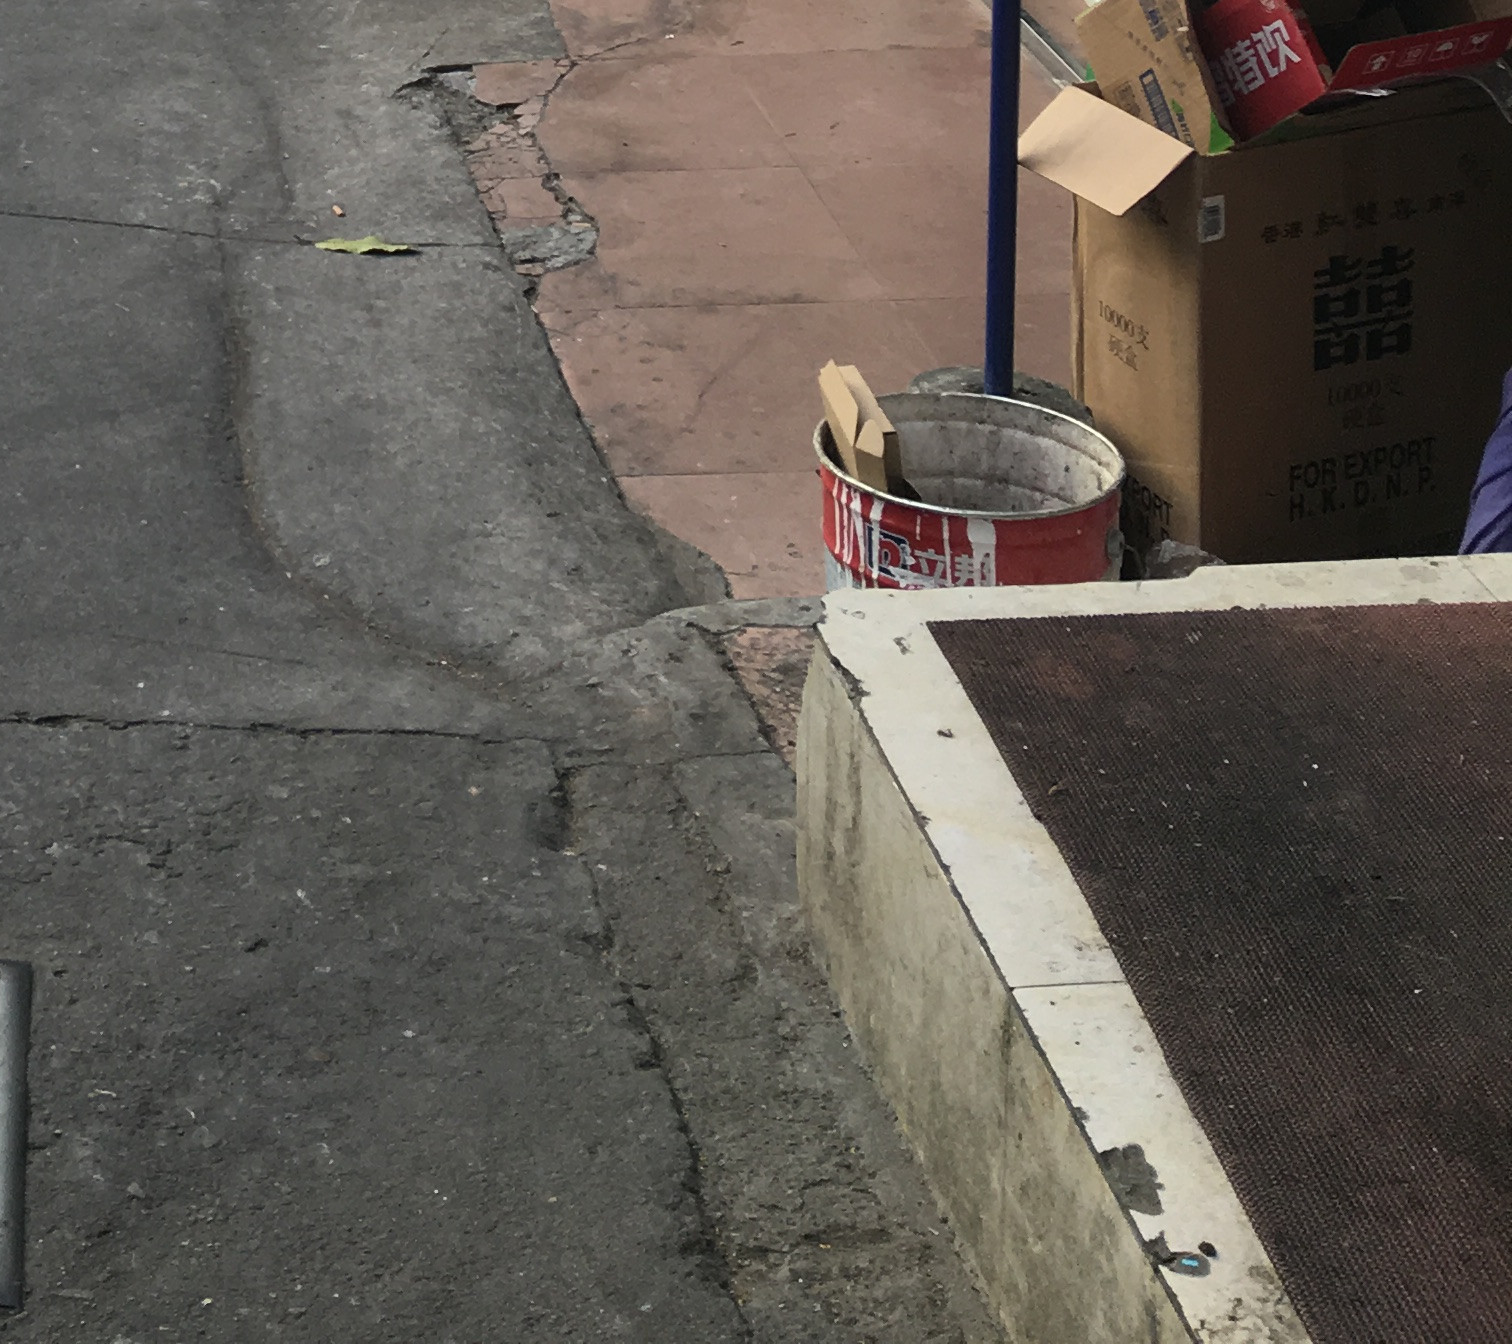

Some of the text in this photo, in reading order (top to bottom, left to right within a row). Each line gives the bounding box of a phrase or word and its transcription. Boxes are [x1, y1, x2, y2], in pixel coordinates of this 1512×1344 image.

[1098, 299, 1151, 352] 10000支
[1289, 437, 1437, 492] FOR EXPORT
